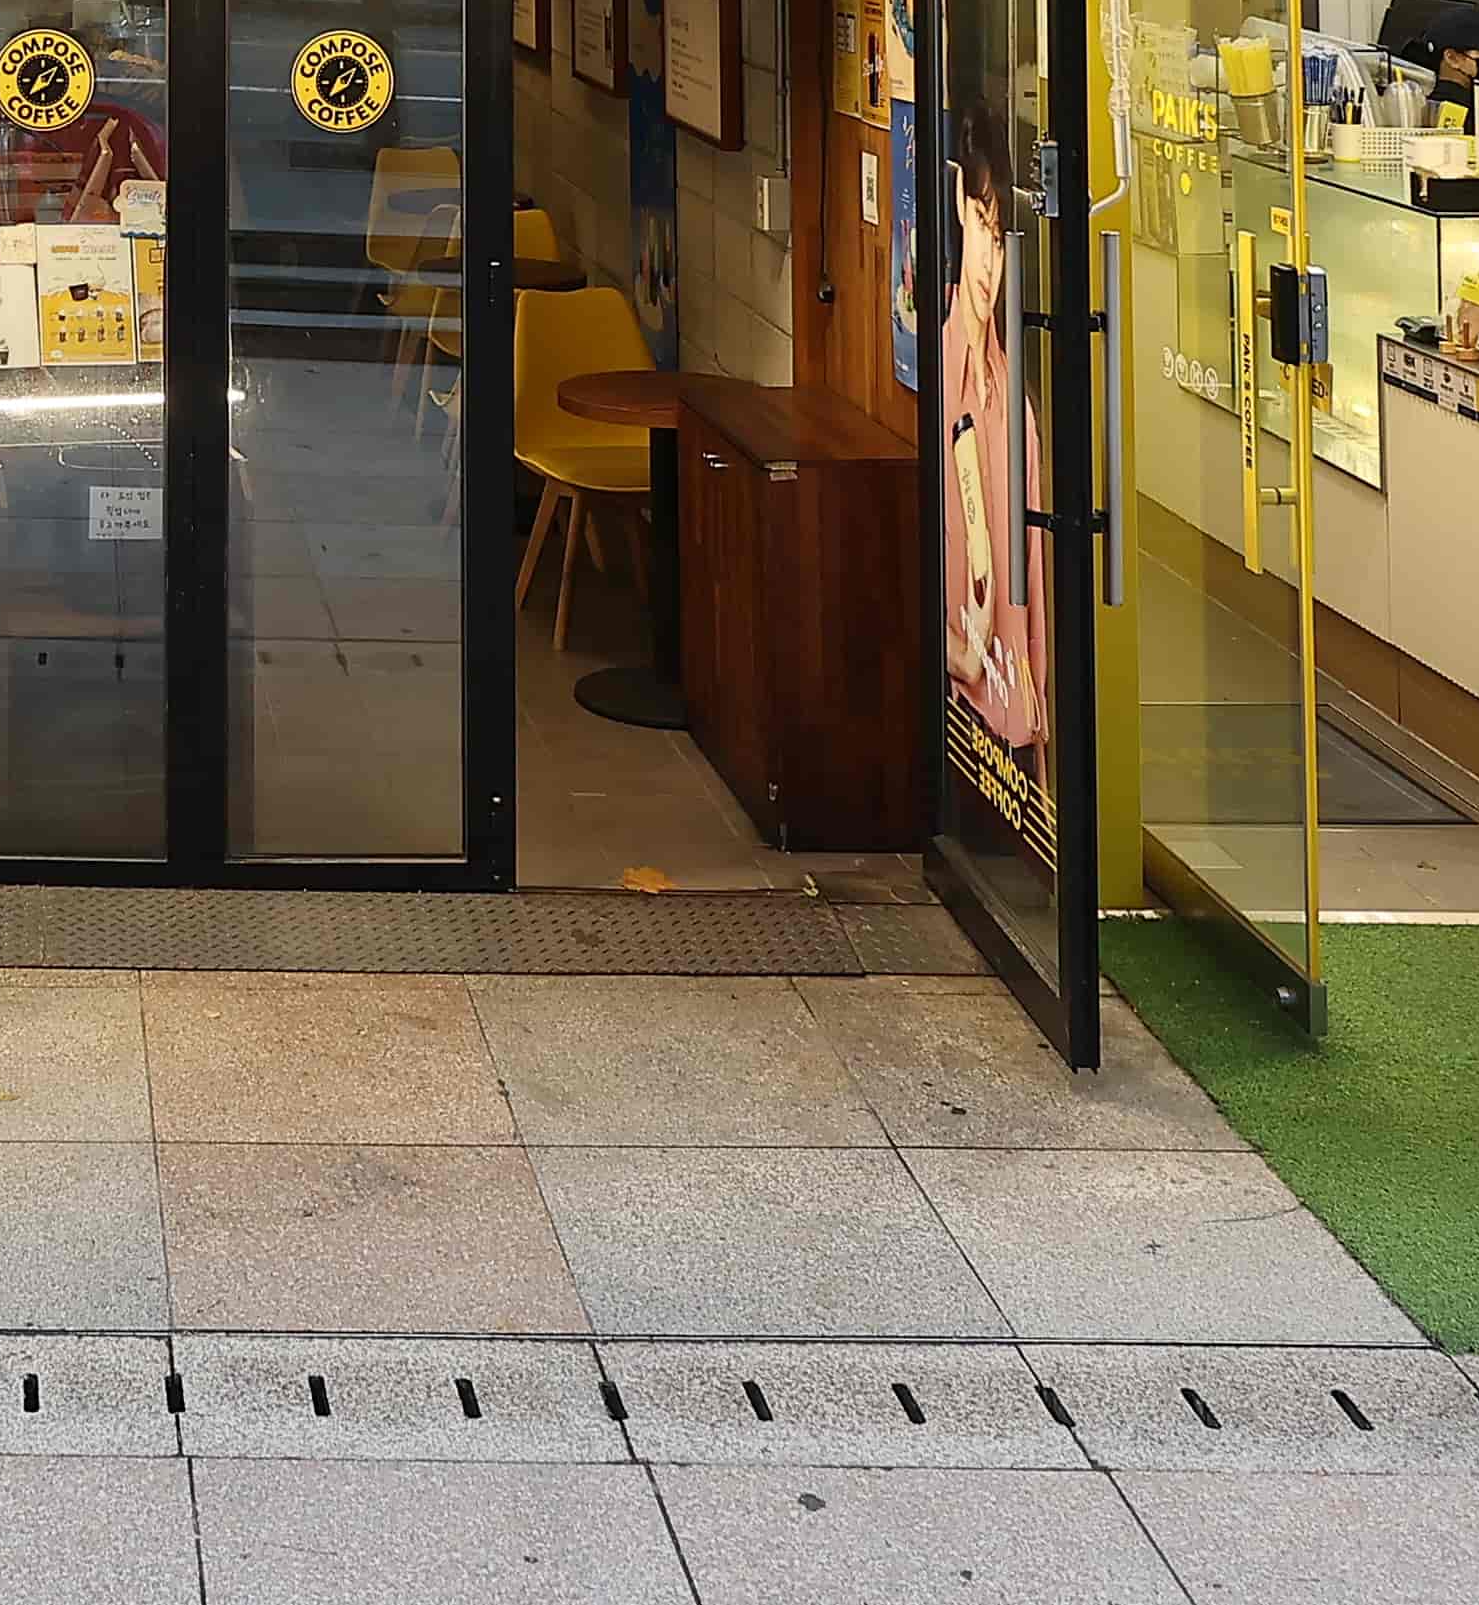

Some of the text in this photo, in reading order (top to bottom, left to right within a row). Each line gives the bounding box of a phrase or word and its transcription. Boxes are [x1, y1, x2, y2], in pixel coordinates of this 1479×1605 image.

[2, 37, 85, 76] COMPOSE
[300, 38, 385, 77] COMPOSE
[8, 96, 80, 123] COFFEE
[308, 96, 380, 125] COFFEE
[1151, 89, 1217, 142] PAIK'S
[1151, 139, 1217, 175] COFFEE
